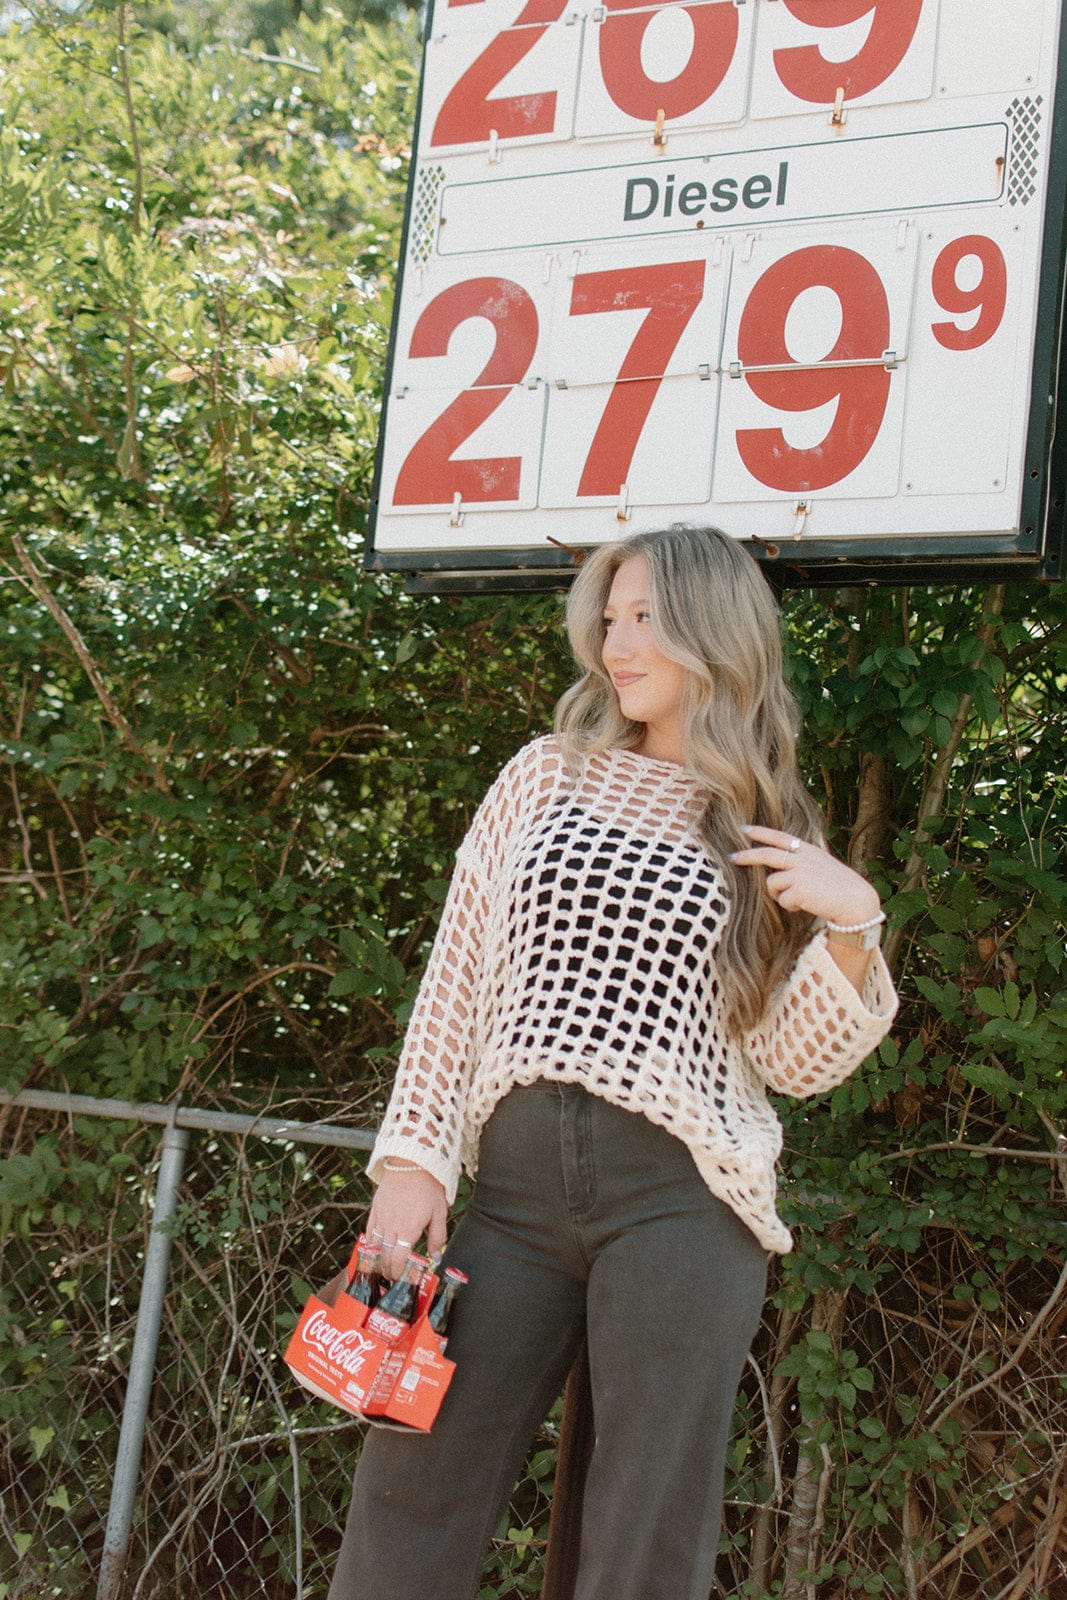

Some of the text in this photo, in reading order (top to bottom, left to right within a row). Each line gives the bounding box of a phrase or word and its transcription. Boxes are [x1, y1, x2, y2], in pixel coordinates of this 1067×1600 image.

[623, 162, 788, 221] Diesel
[302, 1310, 376, 1375] Coca-Cola
[368, 1310, 404, 1337] Coca-Cola
